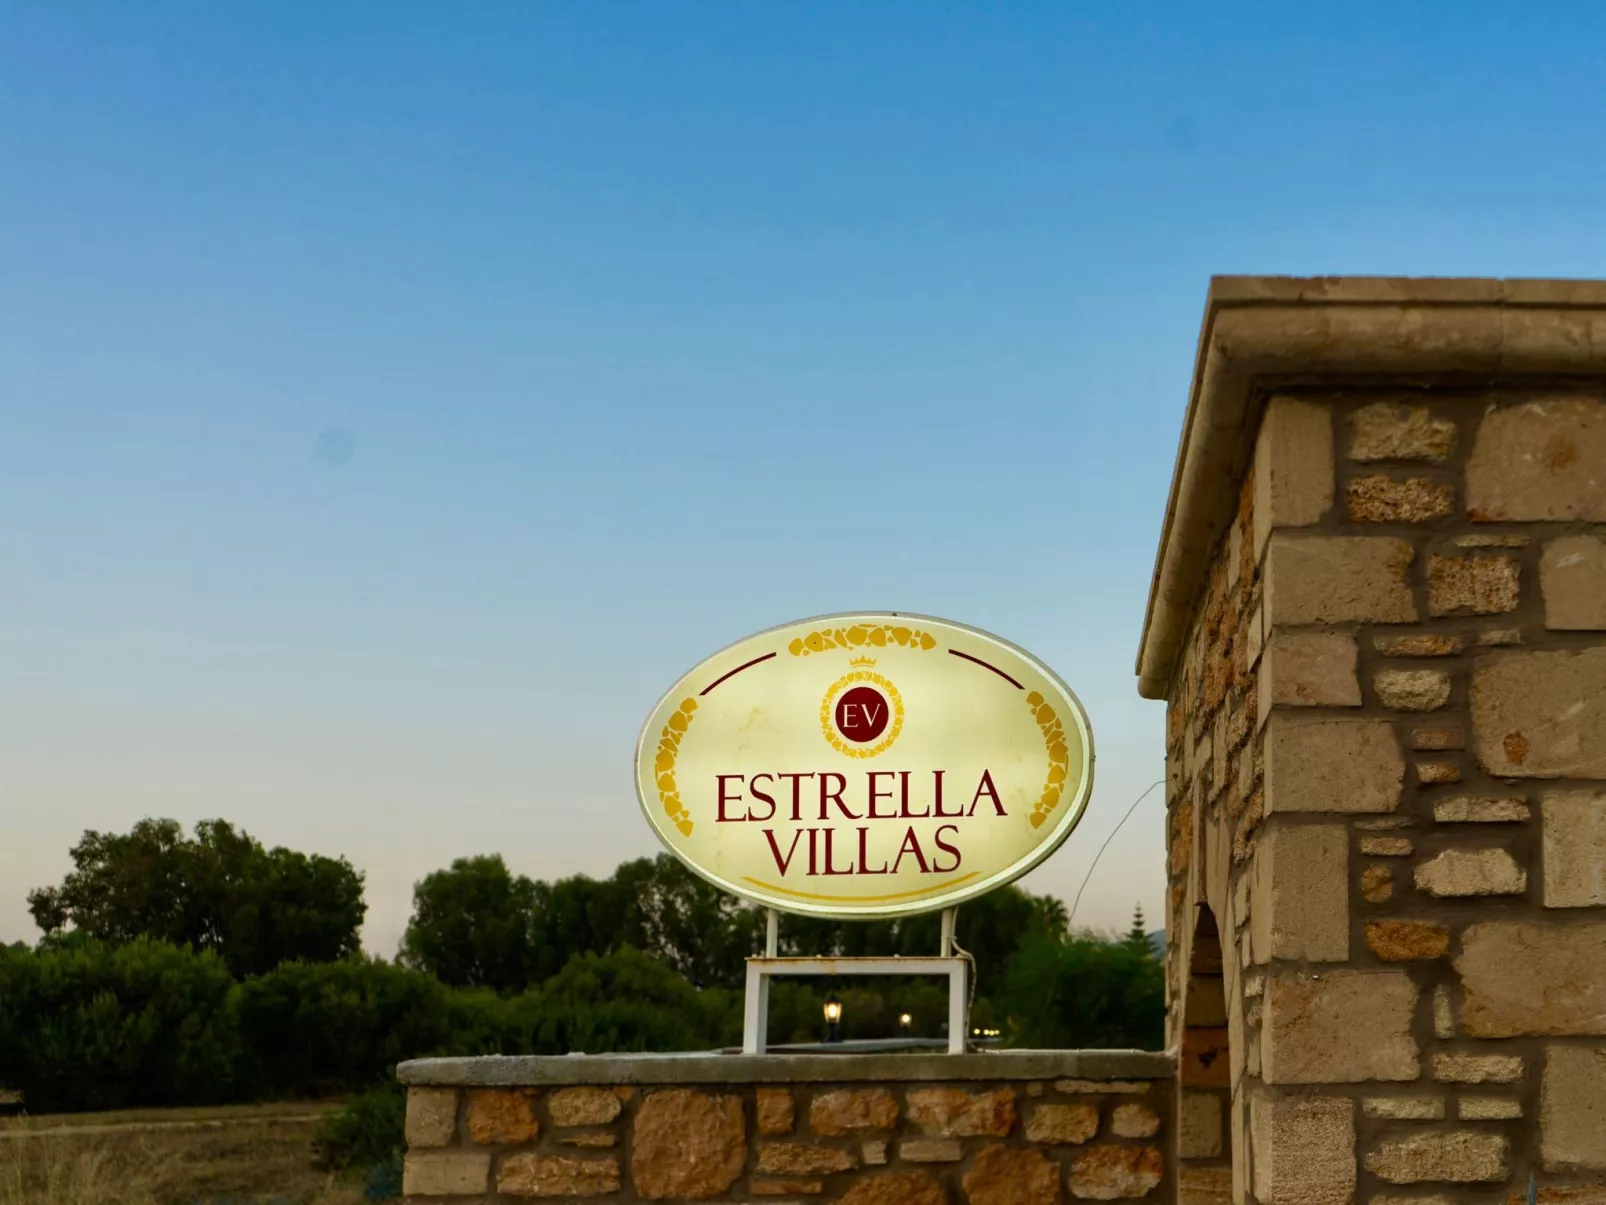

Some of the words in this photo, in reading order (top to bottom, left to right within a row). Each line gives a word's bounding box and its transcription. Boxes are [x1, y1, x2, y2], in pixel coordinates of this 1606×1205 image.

[843, 703, 881, 728] EV
[715, 769, 1008, 822] ESTRELLA
[762, 825, 962, 877] VILLAS
